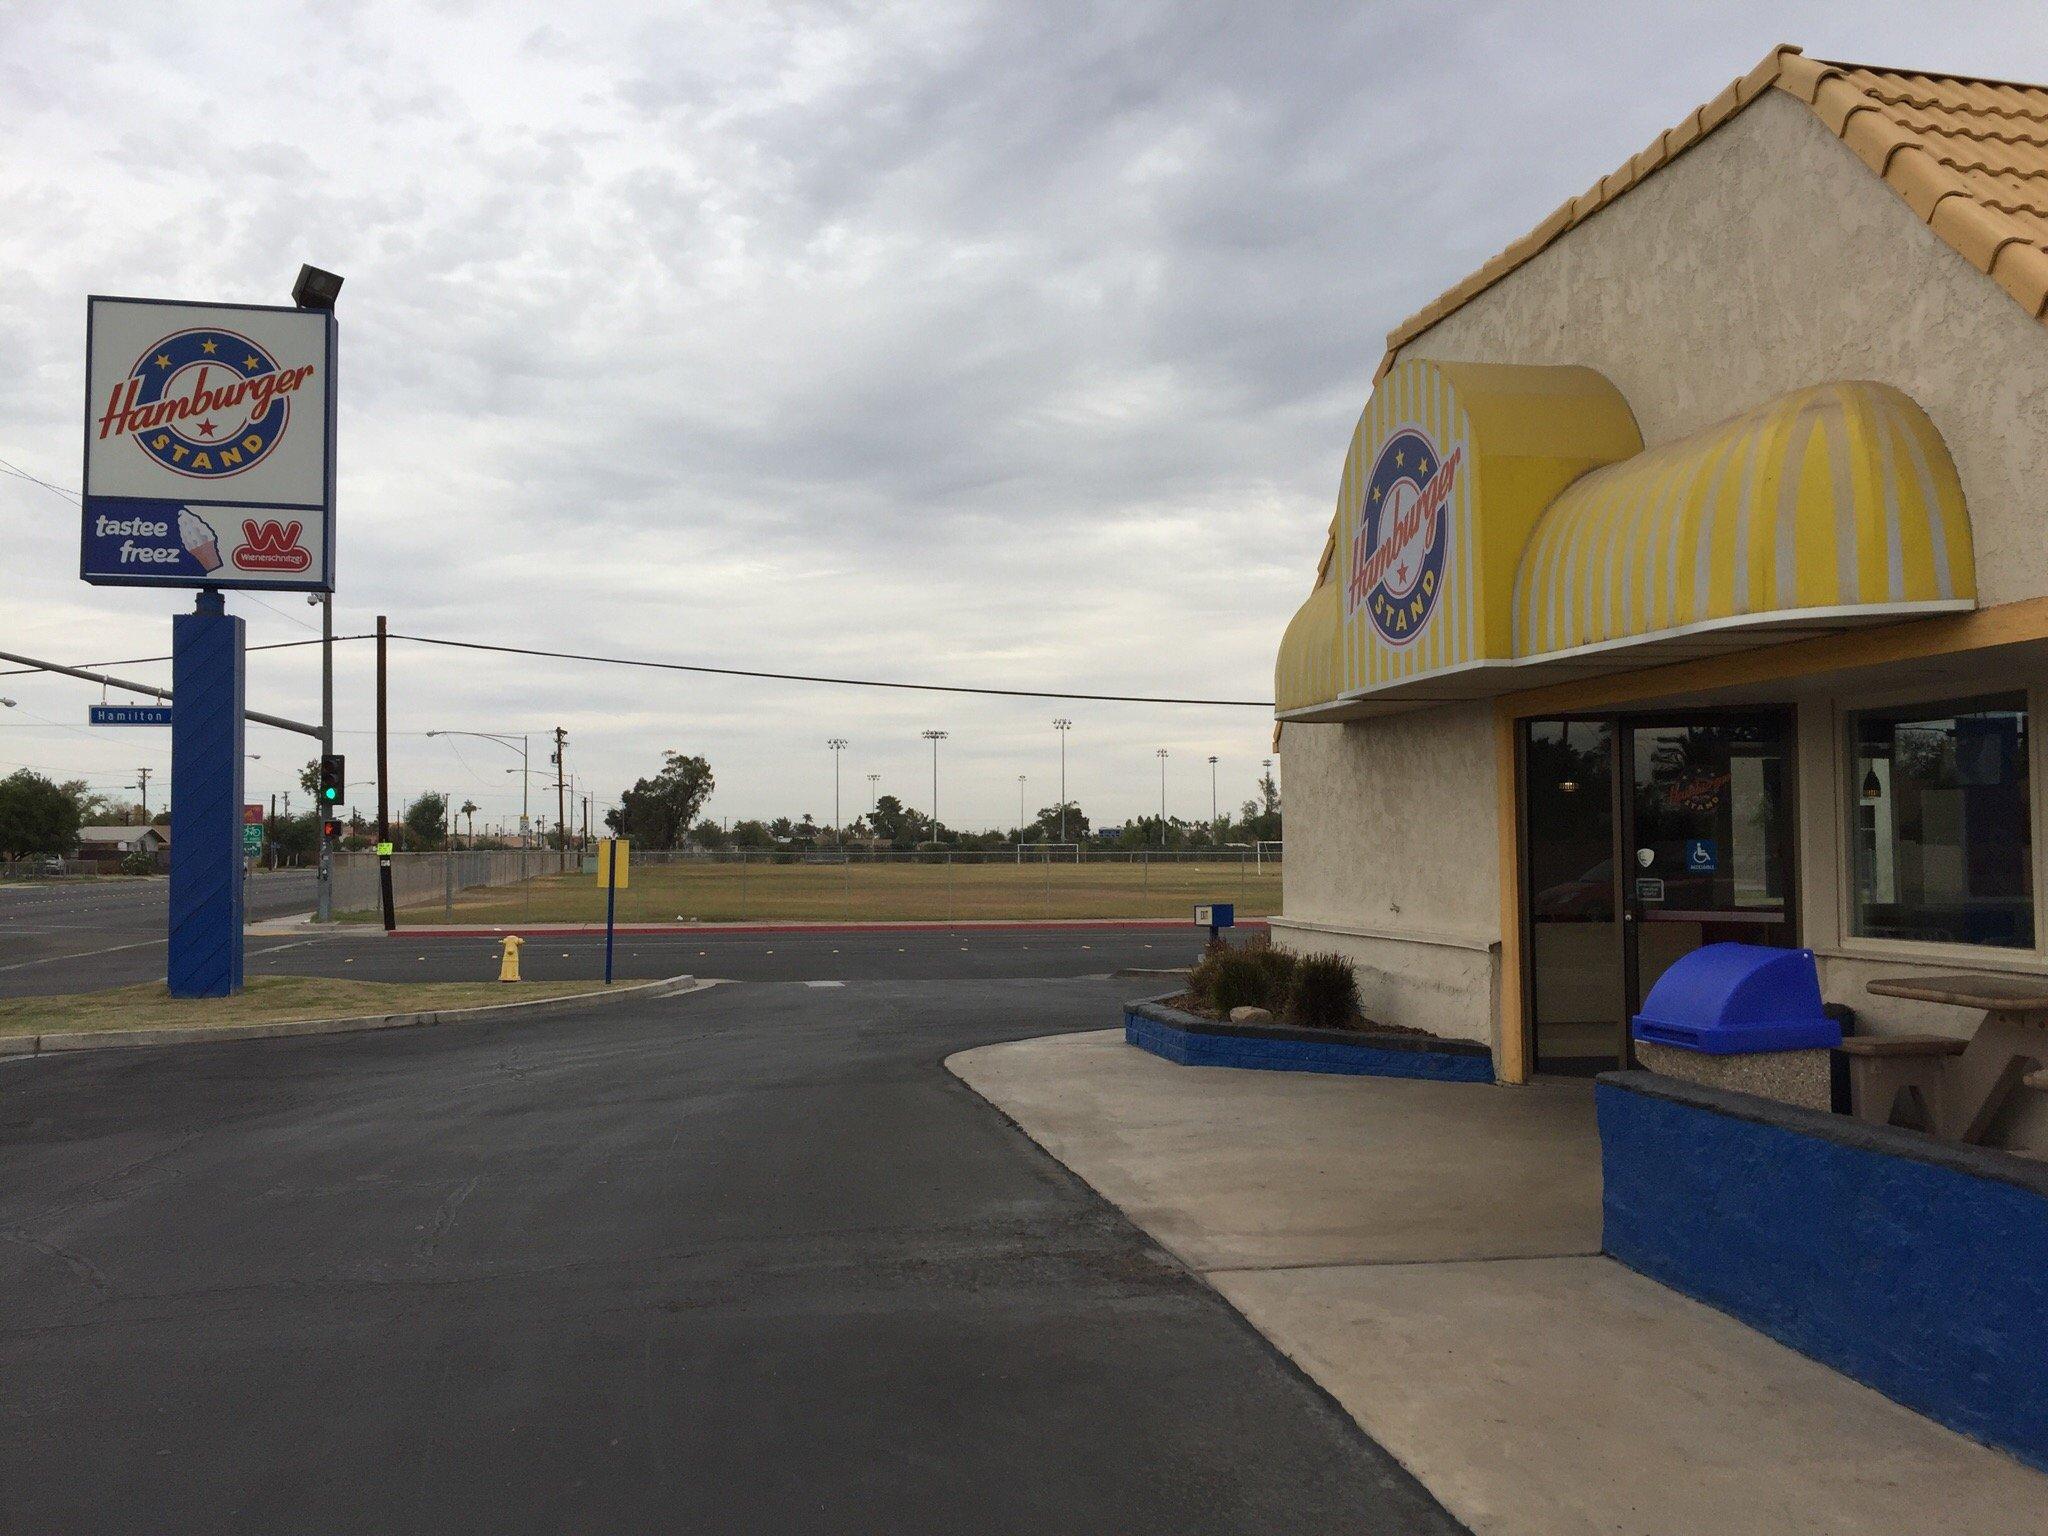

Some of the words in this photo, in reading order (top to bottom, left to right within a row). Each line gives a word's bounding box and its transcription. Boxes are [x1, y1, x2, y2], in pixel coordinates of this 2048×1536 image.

[98, 363, 314, 439] Hamburger
[152, 434, 262, 469] STAND
[96, 514, 168, 537] tastee
[1349, 446, 1461, 615] Hamburger
[119, 539, 180, 563] freez
[241, 553, 303, 564] Wienerschnitzel
[1375, 571, 1435, 631] STAND
[98, 710, 162, 721] Hamilton
